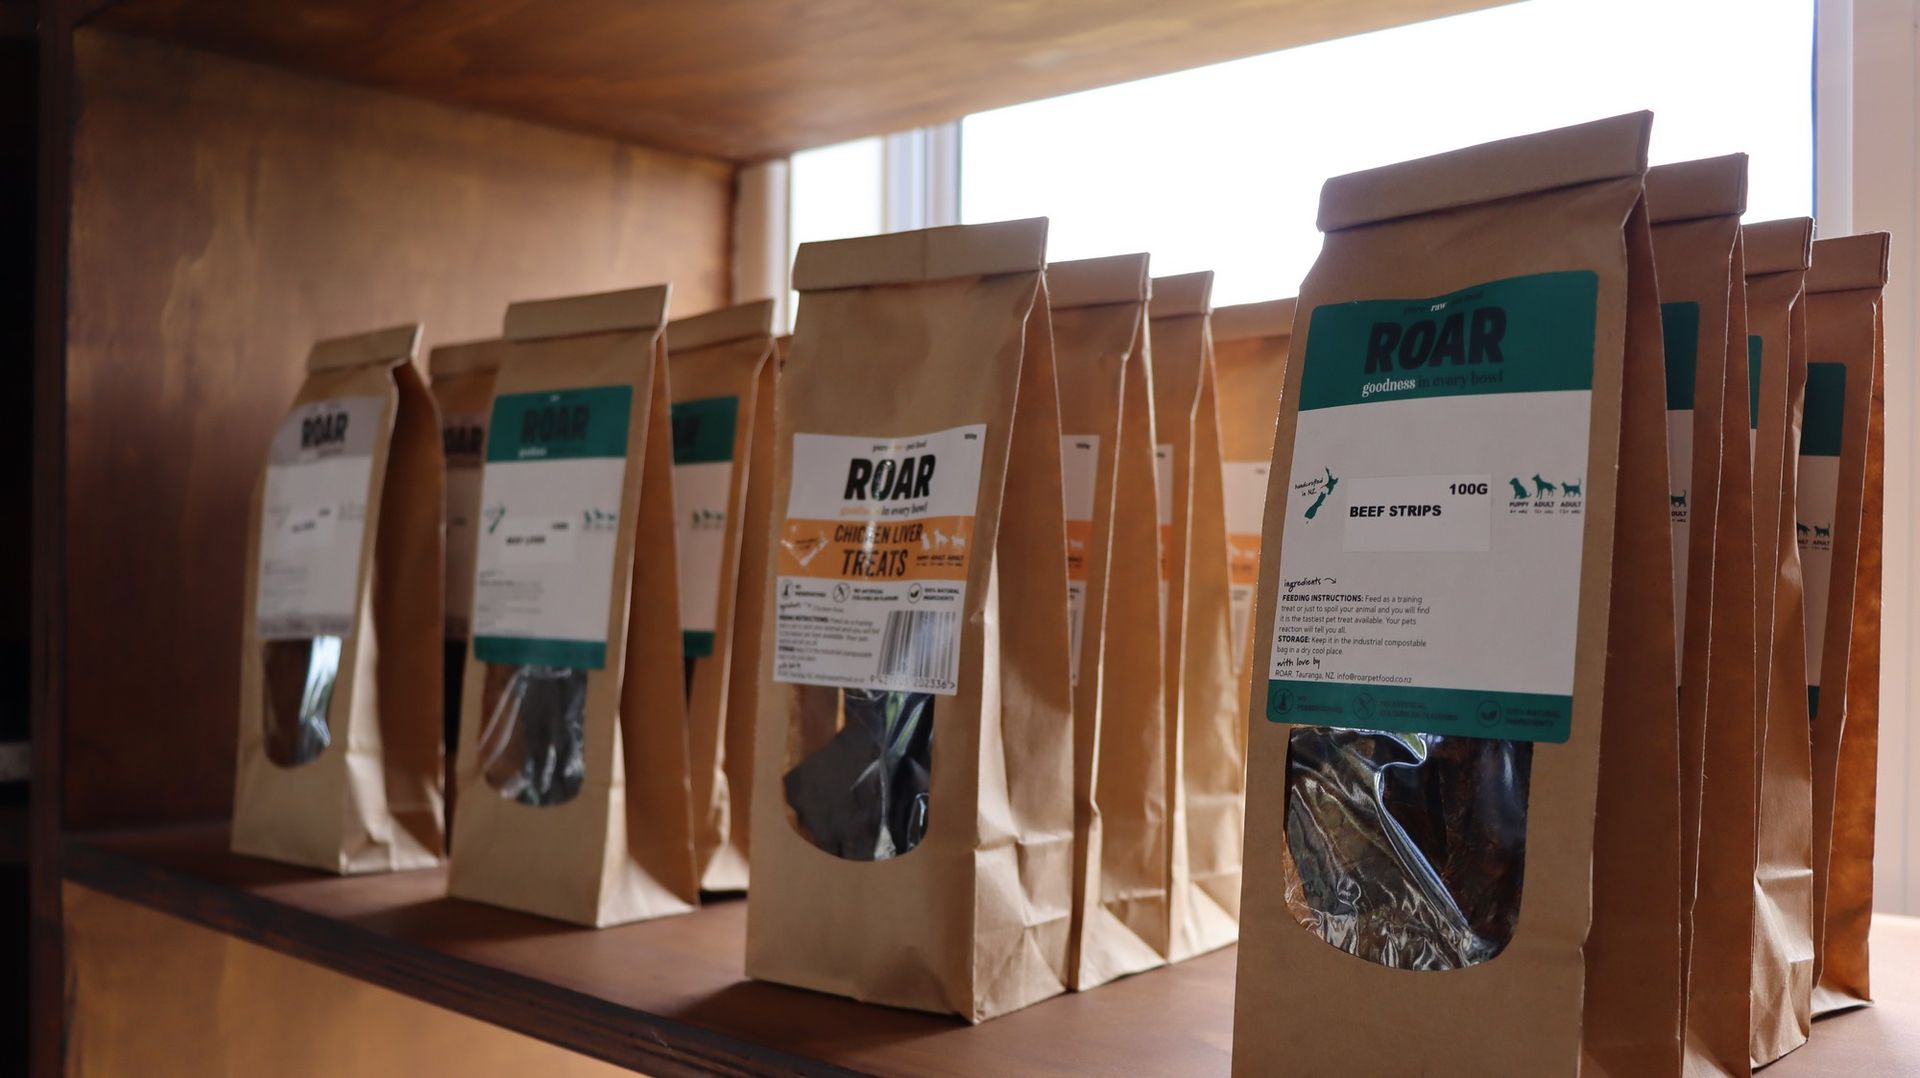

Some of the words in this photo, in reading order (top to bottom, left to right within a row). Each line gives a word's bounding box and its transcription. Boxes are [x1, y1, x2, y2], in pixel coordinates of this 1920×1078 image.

[1431, 302, 1447, 312] raw
[1364, 306, 1507, 374] ROAR
[1361, 378, 1416, 397] goodness
[1468, 368, 1503, 384] bowl
[521, 405, 590, 443] ROAR
[844, 454, 935, 501] ROAR
[1449, 483, 1489, 495] 100G
[1350, 506, 1385, 517] BEEF
[1389, 505, 1442, 517] STRIPS
[834, 524, 891, 544] CHICEN
[893, 523, 923, 544] LIVER
[842, 548, 908, 577] TREATS
[1284, 577, 1322, 593] ingredients
[1282, 594, 1310, 602] FEEDING
[1311, 594, 1364, 602] INSTRUCTIONS:
[1397, 596, 1423, 605] training
[1303, 605, 1315, 613] just
[1324, 605, 1339, 613] spoil
[1417, 606, 1431, 614] find
[1326, 616, 1337, 624] pet
[1385, 616, 1401, 624] Your
[1402, 618, 1417, 626] pets
[1325, 627, 1337, 635] you
[1278, 635, 1310, 643] STORAGE:
[1312, 636, 1327, 645] Keep
[1385, 638, 1427, 648] compostable
[1277, 645, 1288, 655] bag
[1301, 646, 1311, 655] dry
[1312, 646, 1325, 654] cool
[1277, 658, 1294, 667] with
[1296, 657, 1310, 666] love
[1312, 656, 1321, 670] by
[1337, 672, 1412, 683] info@roarpetfood.co.nz
